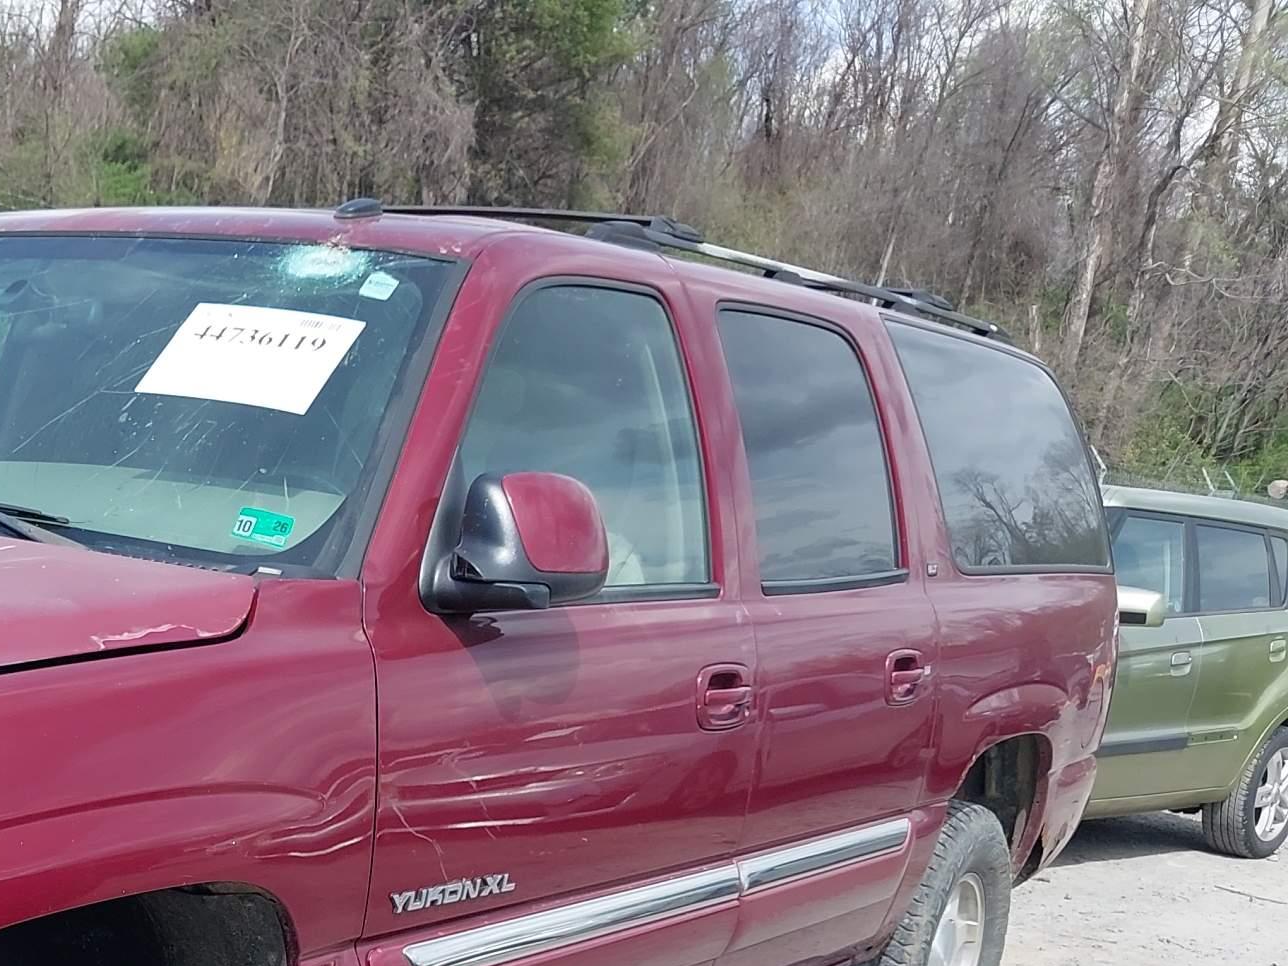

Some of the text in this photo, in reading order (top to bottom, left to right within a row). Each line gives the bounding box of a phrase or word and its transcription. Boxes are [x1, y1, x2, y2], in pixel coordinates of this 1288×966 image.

[194, 325, 327, 351] 44736119
[237, 519, 289, 533] 10 26
[391, 879, 481, 913] YUKON
